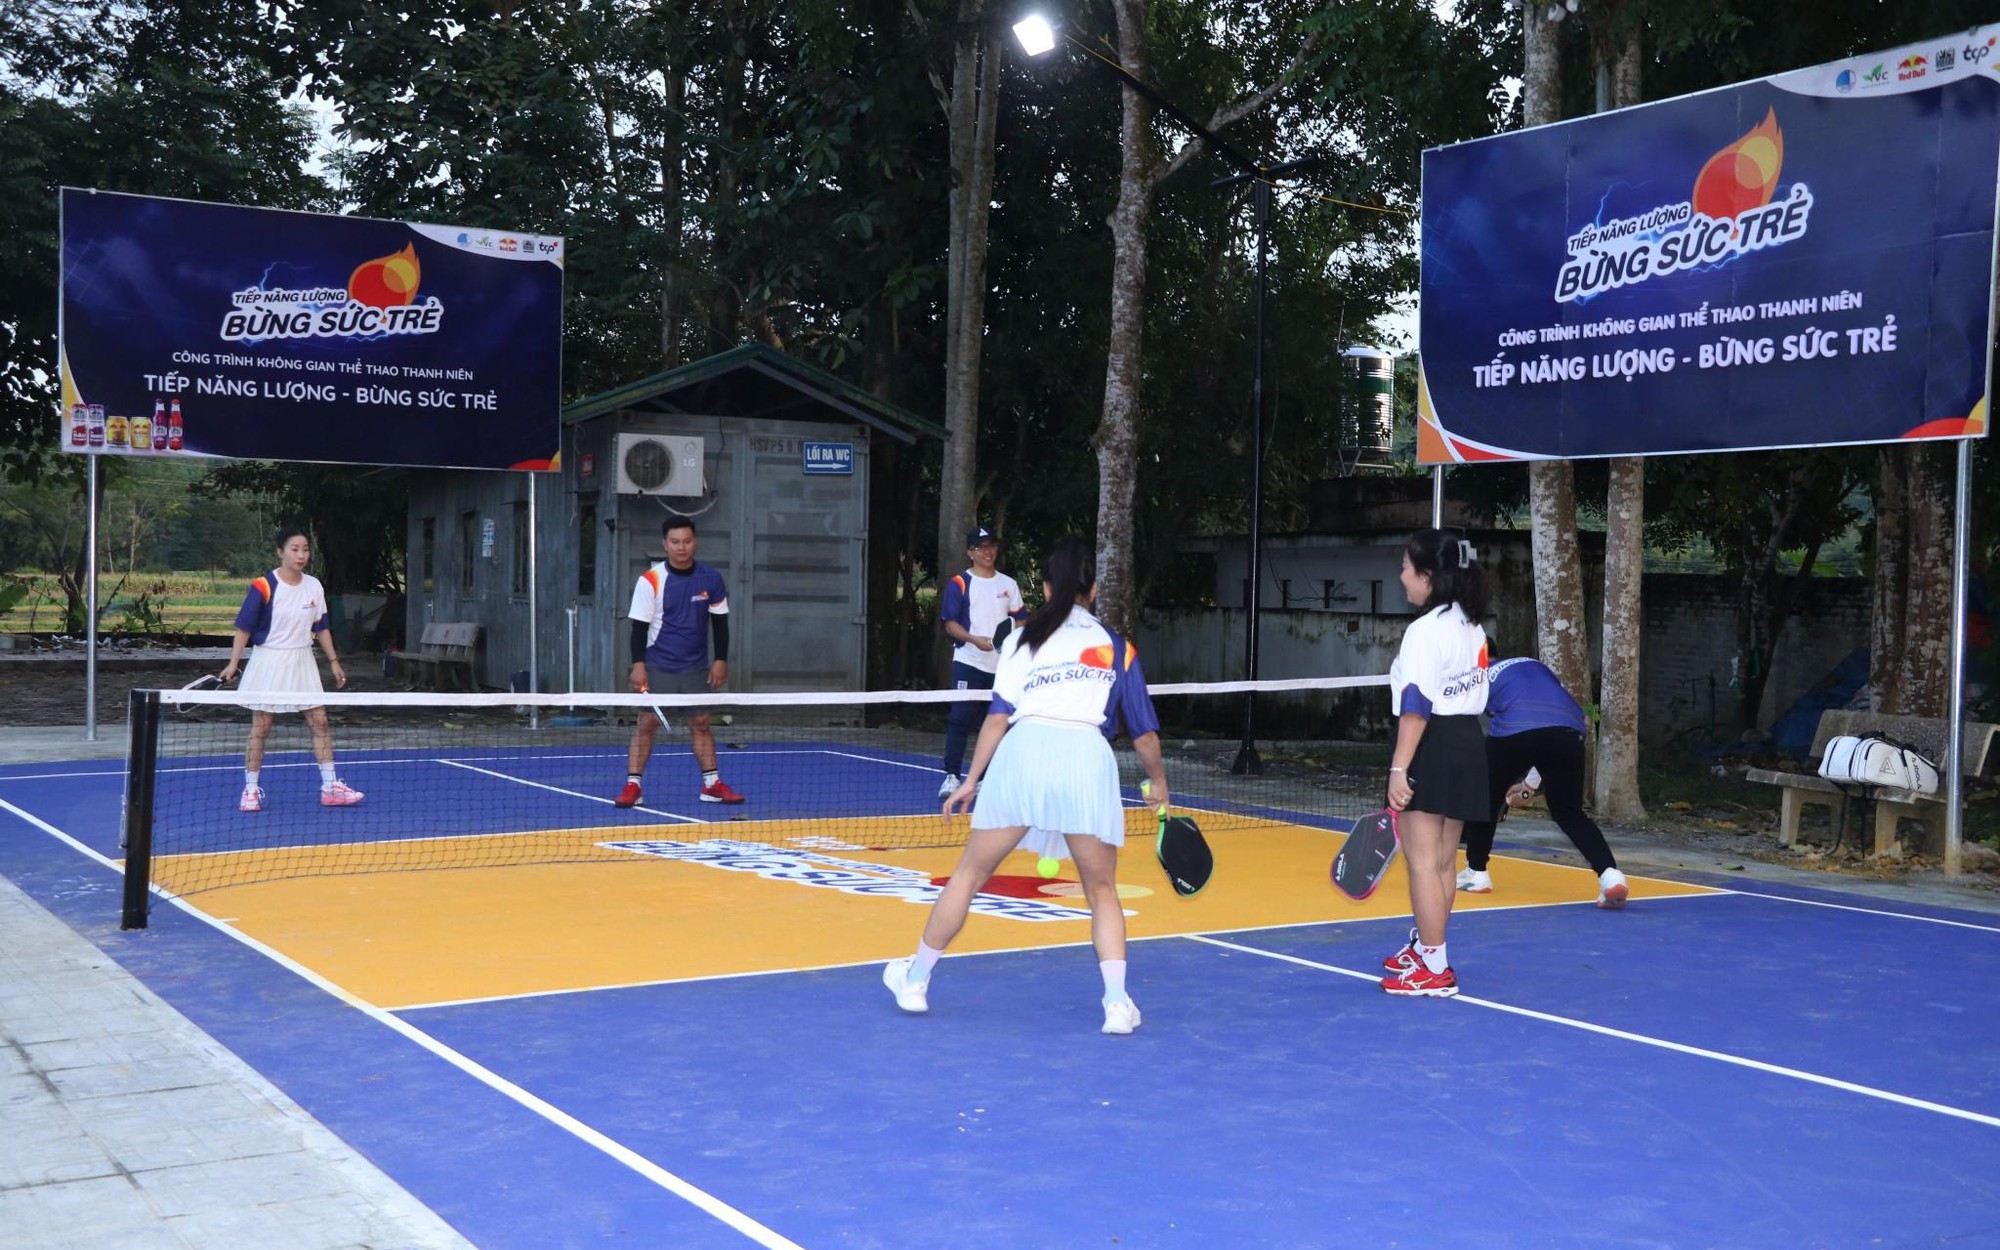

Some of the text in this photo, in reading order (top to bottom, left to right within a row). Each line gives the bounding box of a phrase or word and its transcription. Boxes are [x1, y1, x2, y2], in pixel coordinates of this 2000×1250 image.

[1962, 44, 1989, 65] tcp
[1898, 71, 1912, 81] Red
[1912, 68, 1926, 79] Bull
[1570, 205, 1689, 251] TIẾP NĂNG LƯỢNG
[539, 241, 555, 255] tcp
[1558, 188, 1808, 298] BỪNG SỨC TRẺ
[234, 288, 345, 306] TIẾP NĂNG LƯỢNG
[225, 300, 440, 337] BỪNG SỨC TRẺ
[1499, 290, 1863, 347] CÔNG TRÌNH KHÔNG GIAN THỂ THAO THANH NIÊN
[1472, 351, 1516, 388] TIẾP
[1521, 354, 1586, 385] NĂNG
[1592, 347, 1676, 383] LƯỢNG
[1699, 336, 1775, 369] BỪNG
[1782, 326, 1839, 362] SỨC
[1846, 314, 1898, 355] TRẺ
[172, 350, 474, 380] CÔNG TRÌNH KHÔNG GIAN THỂ THAO THANH NIÊN
[143, 370, 191, 393] TIẾP
[197, 374, 258, 397] NĂNG
[264, 380, 336, 402] LƯỢNG
[356, 384, 412, 406] BỪNG
[417, 388, 456, 408] SỨC
[461, 389, 498, 410] TRẺ
[683, 458, 697, 467] LG
[807, 445, 820, 461] LỐI
[822, 448, 833, 461] RA
[835, 448, 850, 461] WC
[1443, 681, 1471, 697] BỪN
